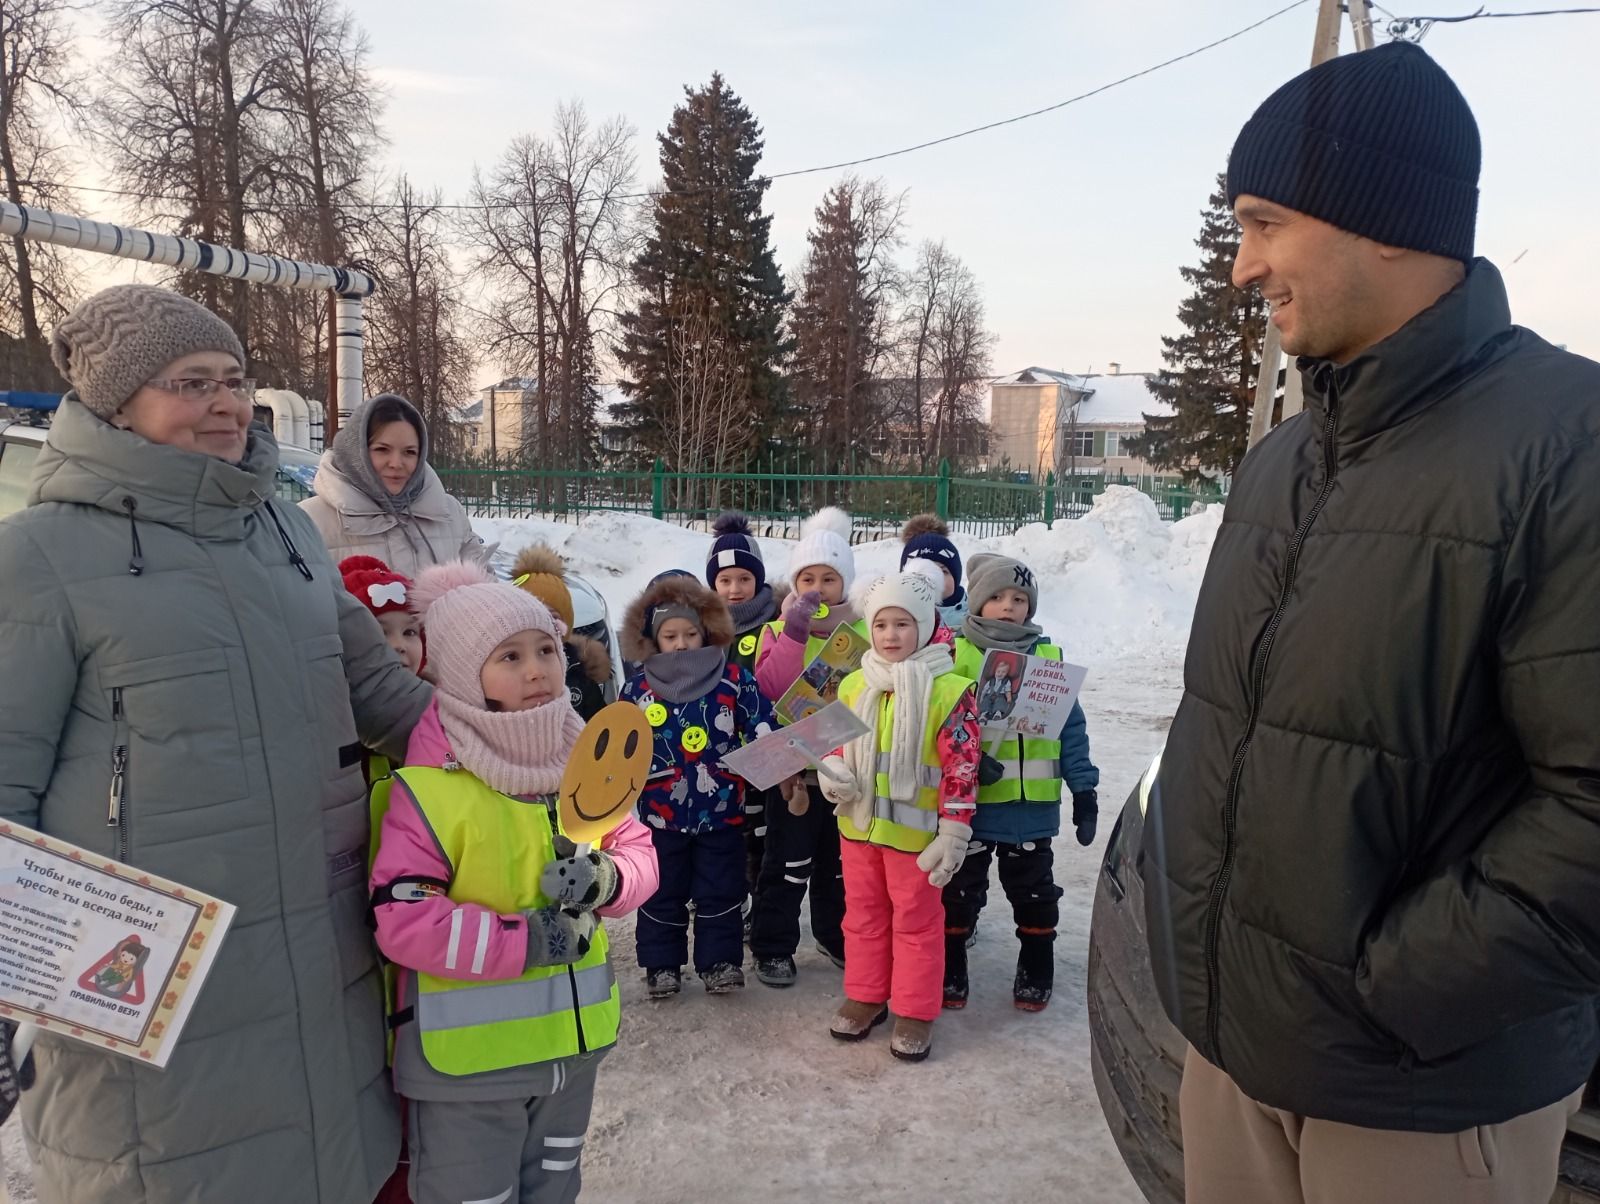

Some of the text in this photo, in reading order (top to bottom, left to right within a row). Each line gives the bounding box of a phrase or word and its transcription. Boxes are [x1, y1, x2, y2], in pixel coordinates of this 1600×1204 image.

[1044, 660, 1064, 669] ЕСЛИ
[1030, 668, 1067, 682] ЛЮБИШЬ,
[1026, 679, 1070, 695] ПРИСТЕГНИ
[1028, 691, 1058, 706] МЕНЯ!
[24, 858, 165, 918] Чтобы не было беды, в
[16, 876, 159, 932] кресле ты всегда вези!
[69, 990, 141, 1018] ПРАВИЛЬНО ВЕЗУ!
